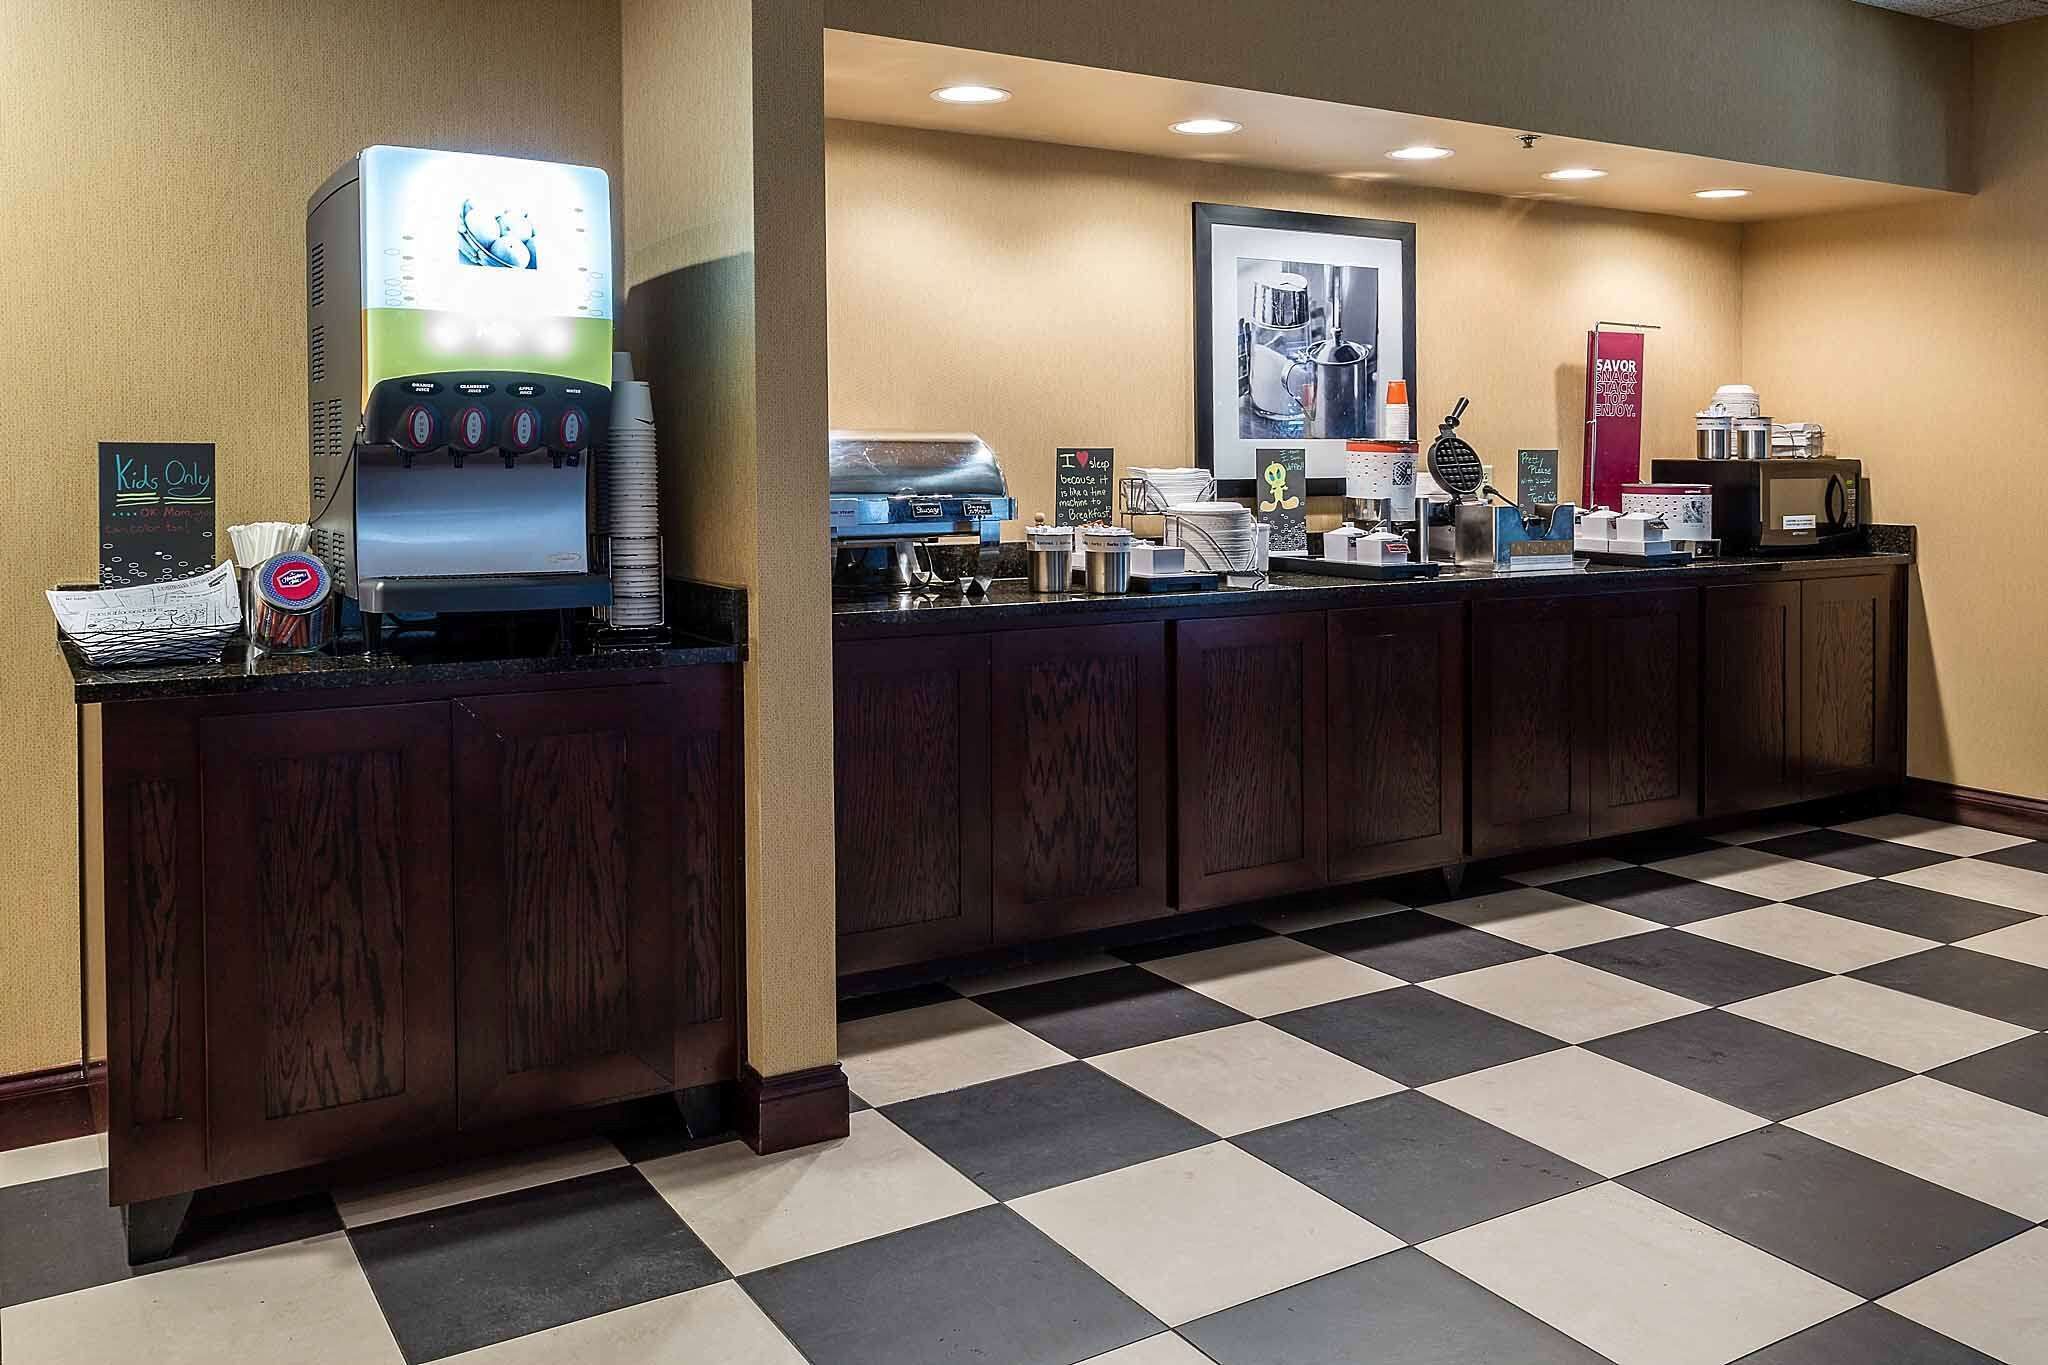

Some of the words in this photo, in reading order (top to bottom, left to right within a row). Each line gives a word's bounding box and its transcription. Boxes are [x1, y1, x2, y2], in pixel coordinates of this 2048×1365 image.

[1597, 359, 1636, 372] SAVOR
[1596, 371, 1637, 383] SNACK
[1596, 382, 1635, 394] STACK
[1603, 393, 1628, 405] TOP
[1595, 404, 1636, 417] ENJOY.
[1060, 453, 1075, 468] I
[1089, 456, 1109, 471] sleep
[116, 454, 158, 490] Kids
[166, 460, 210, 497] Only
[1060, 473, 1096, 485] because
[1082, 489, 1089, 497] a
[1090, 497, 1102, 505] to
